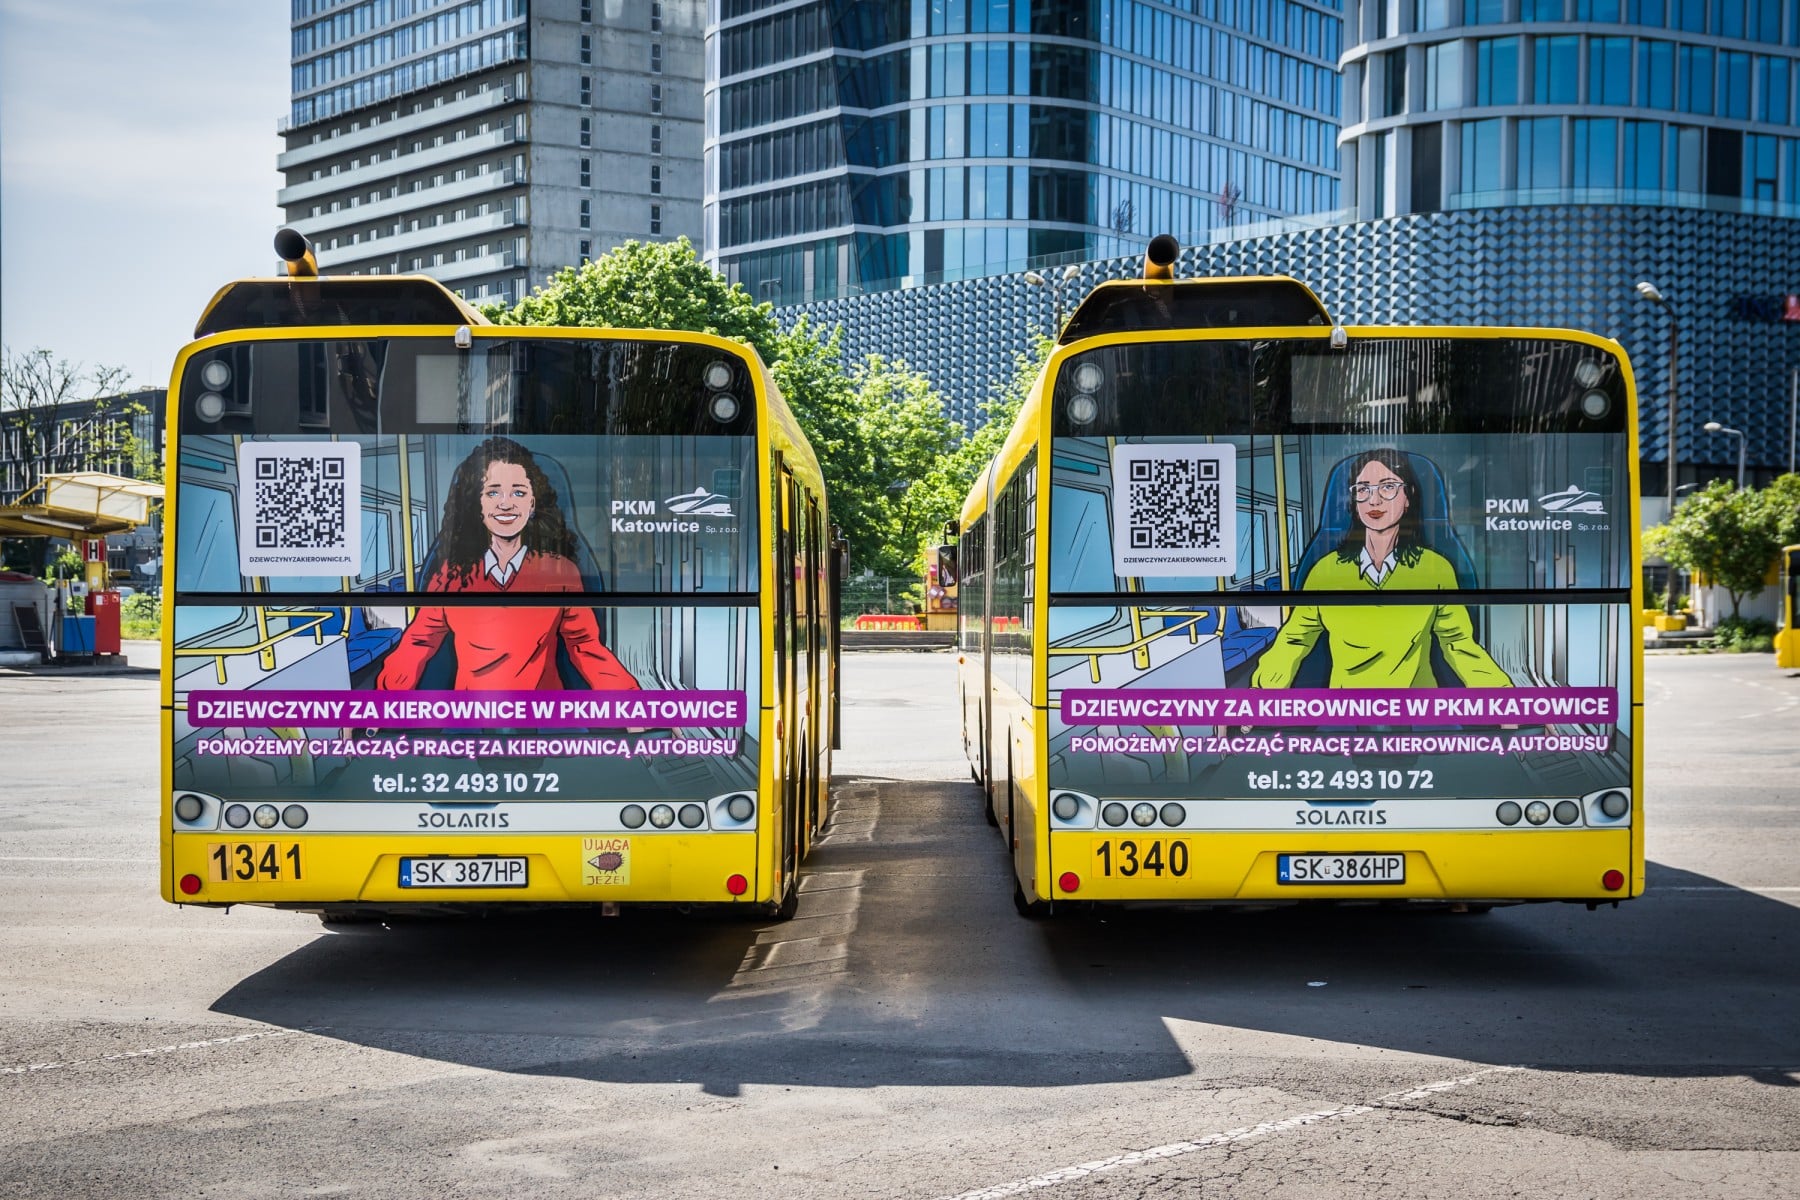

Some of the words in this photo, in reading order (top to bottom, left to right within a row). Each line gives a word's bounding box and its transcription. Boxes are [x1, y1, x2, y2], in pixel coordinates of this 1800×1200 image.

[611, 500, 656, 515] PKM
[1485, 499, 1529, 514] PKM
[611, 518, 700, 533] Katowice
[705, 525, 718, 534] Sp.
[1485, 516, 1573, 531] Katowice
[1577, 523, 1590, 532] Sp.
[89, 541, 99, 560] H
[1123, 556, 1228, 564] DZIEWCZYNYZAKIEROWNICE.PL
[197, 701, 344, 719] DZIEWCZYNY
[350, 701, 379, 719] ZA
[384, 701, 527, 719] KIEROWNICE
[531, 701, 555, 719] W
[560, 701, 610, 719] PKM
[615, 701, 737, 719] KATOWICE
[1071, 699, 1219, 717] DZIEWCZYNY
[1224, 699, 1254, 717] ZA
[1258, 698, 1401, 717] KIEROWNICE
[1406, 699, 1429, 716] W
[1434, 698, 1483, 716] PKM
[1489, 697, 1609, 716] KATOWICE
[198, 736, 306, 755] POMOŻEMY
[308, 740, 328, 755] CI
[332, 736, 409, 759] ZACZĄĆ
[414, 739, 475, 759] PRACĘ
[479, 740, 504, 755] ZA
[508, 740, 631, 759] KIEROWNICĄ
[634, 740, 736, 755] AUTOBUSU
[1071, 734, 1180, 753] POMOŻEMY
[1183, 738, 1202, 753] CI
[1206, 733, 1284, 757] ZACZĄĆ
[1289, 737, 1350, 756] PRACĘ
[1354, 738, 1378, 752] ZA
[1382, 737, 1505, 756] KIEROWNICĄ
[1508, 736, 1609, 752] AUTOBUSU
[373, 774, 416, 793] tel.:
[422, 774, 449, 793] 32
[454, 774, 499, 793] 493
[503, 774, 528, 793] 10
[532, 774, 560, 793] 72
[1248, 770, 1291, 790] tel.:
[1297, 771, 1325, 790] 32
[1329, 770, 1373, 790] 493
[1378, 771, 1403, 789] 10
[1407, 770, 1434, 789] 72
[418, 813, 509, 828] SOLARIS
[1295, 810, 1387, 825] SOLARIS
[584, 838, 630, 851] UWAGA
[213, 843, 302, 881] 1341
[1096, 840, 1189, 877] 1340
[1293, 858, 1324, 879] SK
[1333, 857, 1400, 879] 386HP
[415, 862, 446, 883] SK
[455, 861, 522, 882] 387HP
